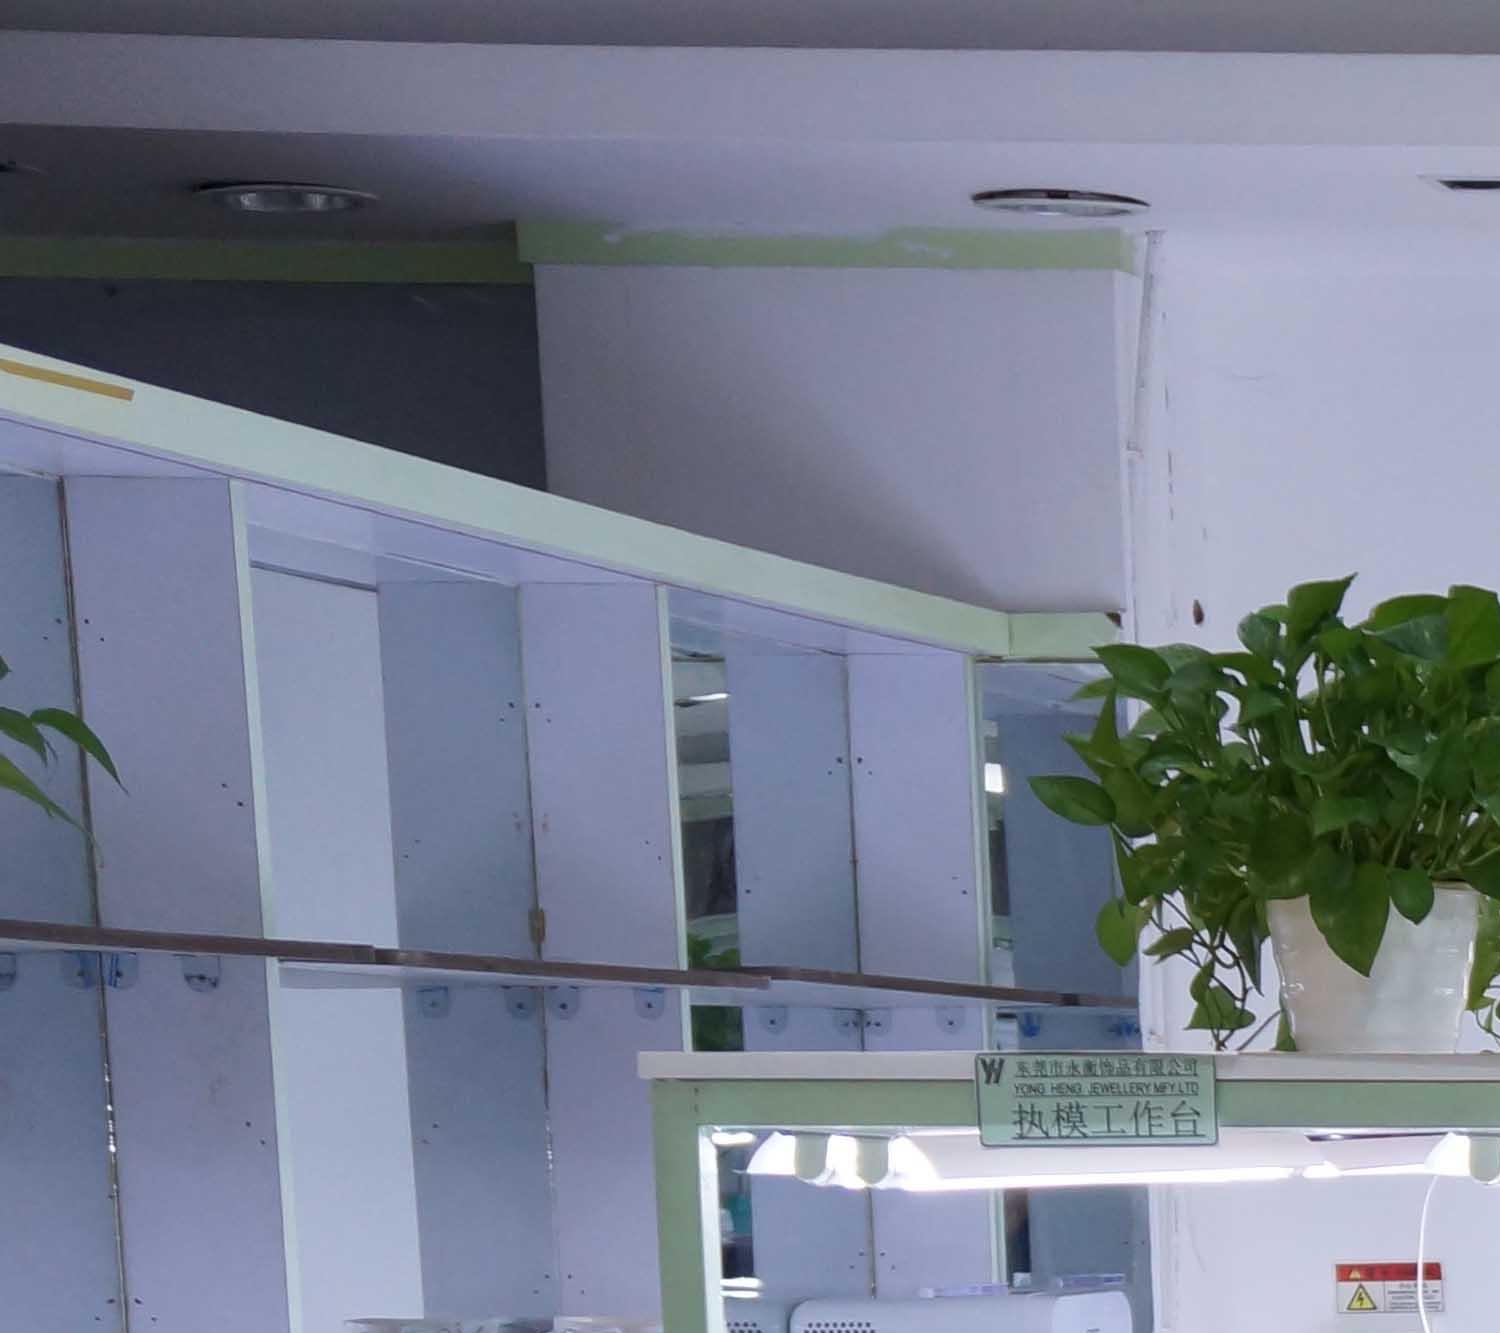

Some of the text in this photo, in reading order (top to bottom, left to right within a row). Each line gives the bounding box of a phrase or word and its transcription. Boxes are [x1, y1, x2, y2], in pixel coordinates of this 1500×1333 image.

[1014, 1081, 1045, 1095] YONG
[1051, 1081, 1082, 1095] HENG
[1088, 1081, 1151, 1096] JEWELLERY
[1012, 1100, 1201, 1139] 执模工作台
